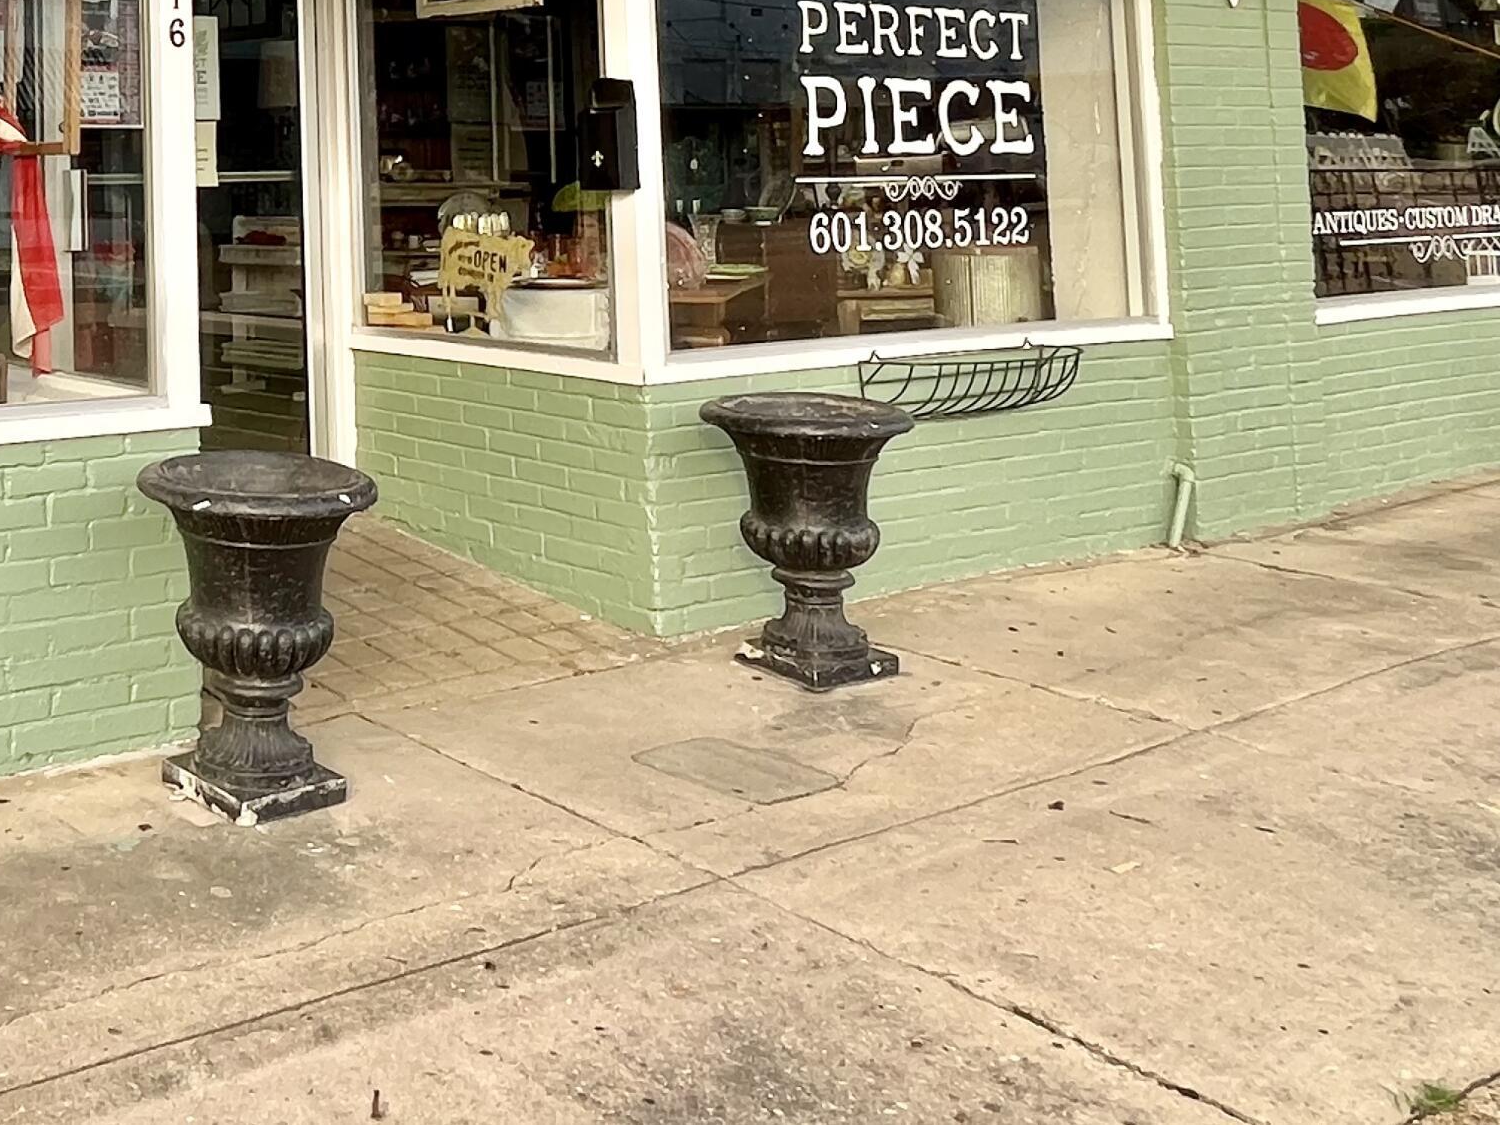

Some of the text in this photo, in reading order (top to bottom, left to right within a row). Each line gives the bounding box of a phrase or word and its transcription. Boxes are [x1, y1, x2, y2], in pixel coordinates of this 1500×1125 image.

[797, 0, 1029, 60] PERFECT
[800, 75, 1035, 155] PIECE
[809, 206, 1030, 254] 601.308.5122
[473, 250, 507, 273] OPEN
